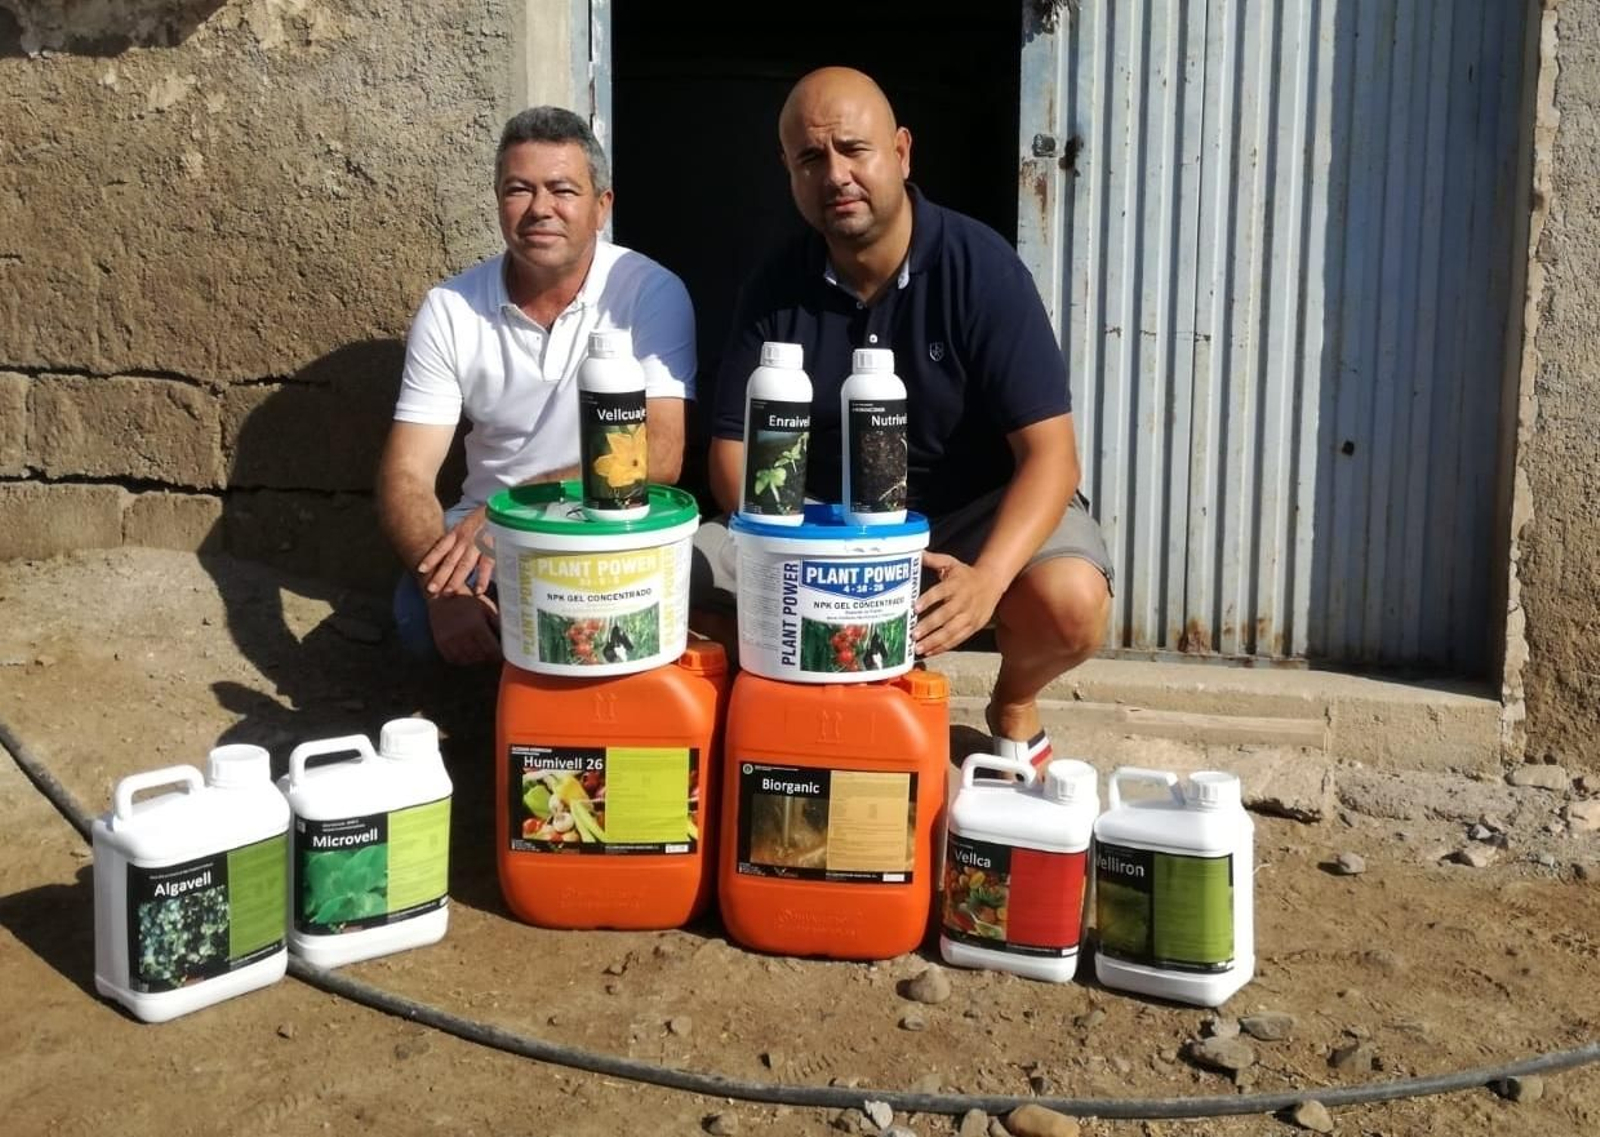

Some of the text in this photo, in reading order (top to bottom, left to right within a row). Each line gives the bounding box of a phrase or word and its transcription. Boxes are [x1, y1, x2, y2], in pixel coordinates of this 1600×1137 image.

[537, 554, 657, 579] PLANT POWER
[807, 563, 909, 584] PLANT POWER
[546, 588, 652, 602] NPK GEL CONCENTRADO
[814, 596, 904, 610] NPK GEL CONCENTRADO
[781, 563, 799, 666] PLANT POWER
[524, 755, 603, 770] Humivell 26
[762, 778, 820, 795] Biorganic
[313, 826, 378, 848] Microvell
[955, 849, 992, 868] Vellca
[154, 870, 212, 898] Algavell
